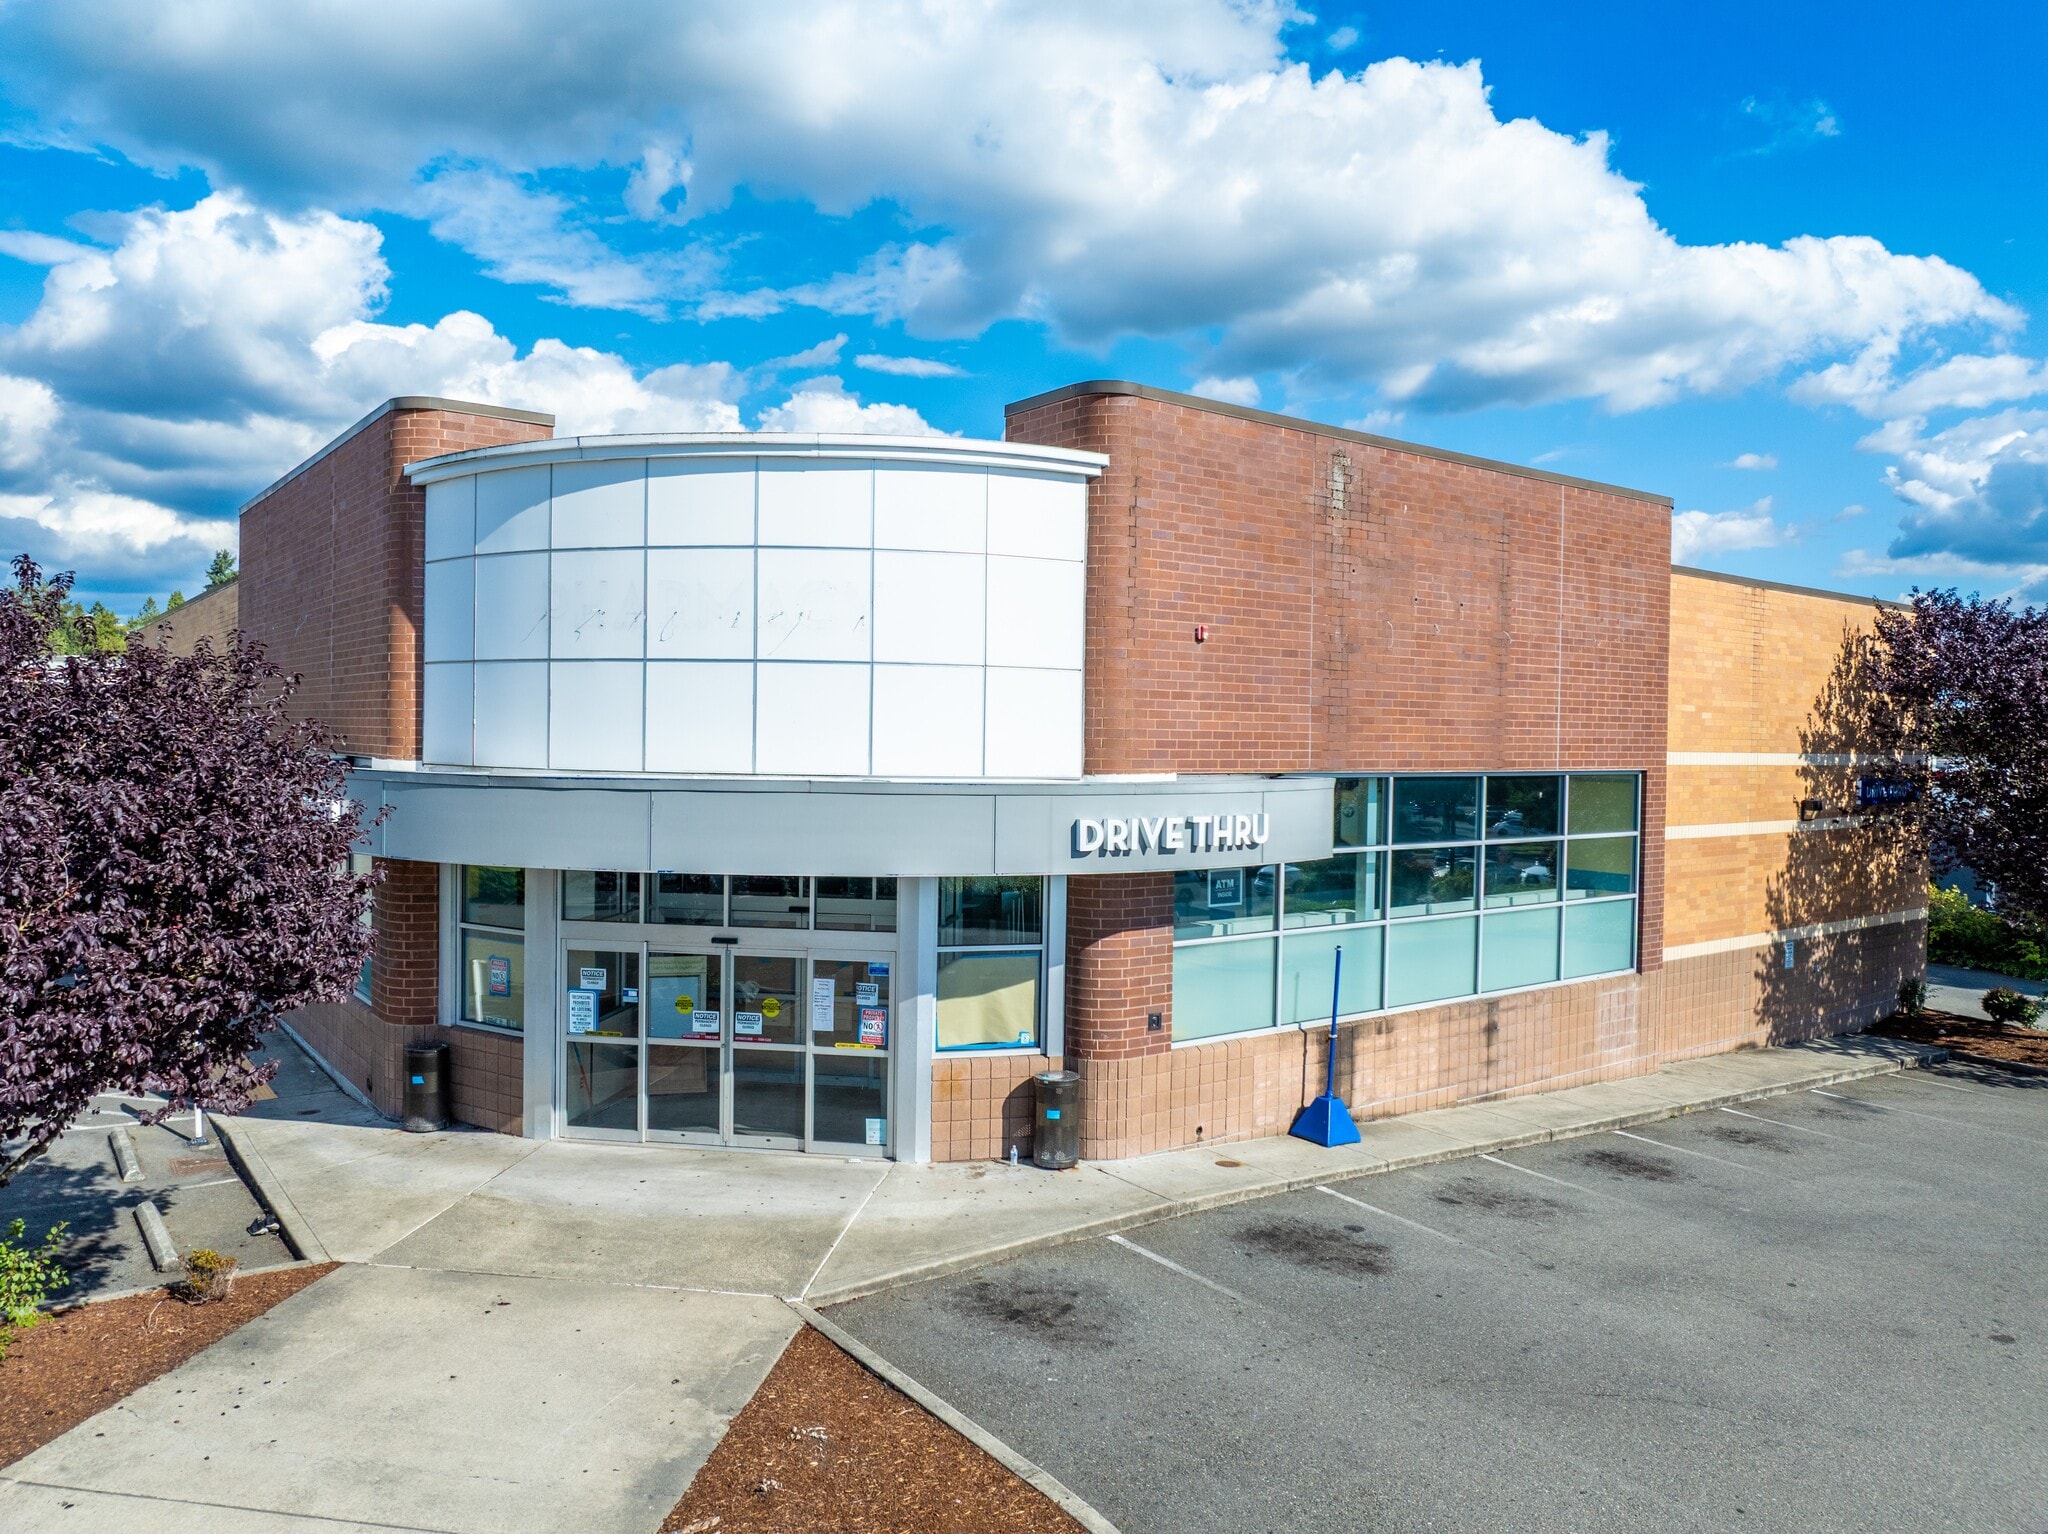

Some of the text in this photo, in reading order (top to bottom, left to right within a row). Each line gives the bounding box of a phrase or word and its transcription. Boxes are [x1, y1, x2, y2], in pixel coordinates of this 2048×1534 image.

[1077, 813, 1270, 852] DRIVE THRU
[1215, 879, 1235, 889] ATM
[863, 1022, 873, 1030] NO
